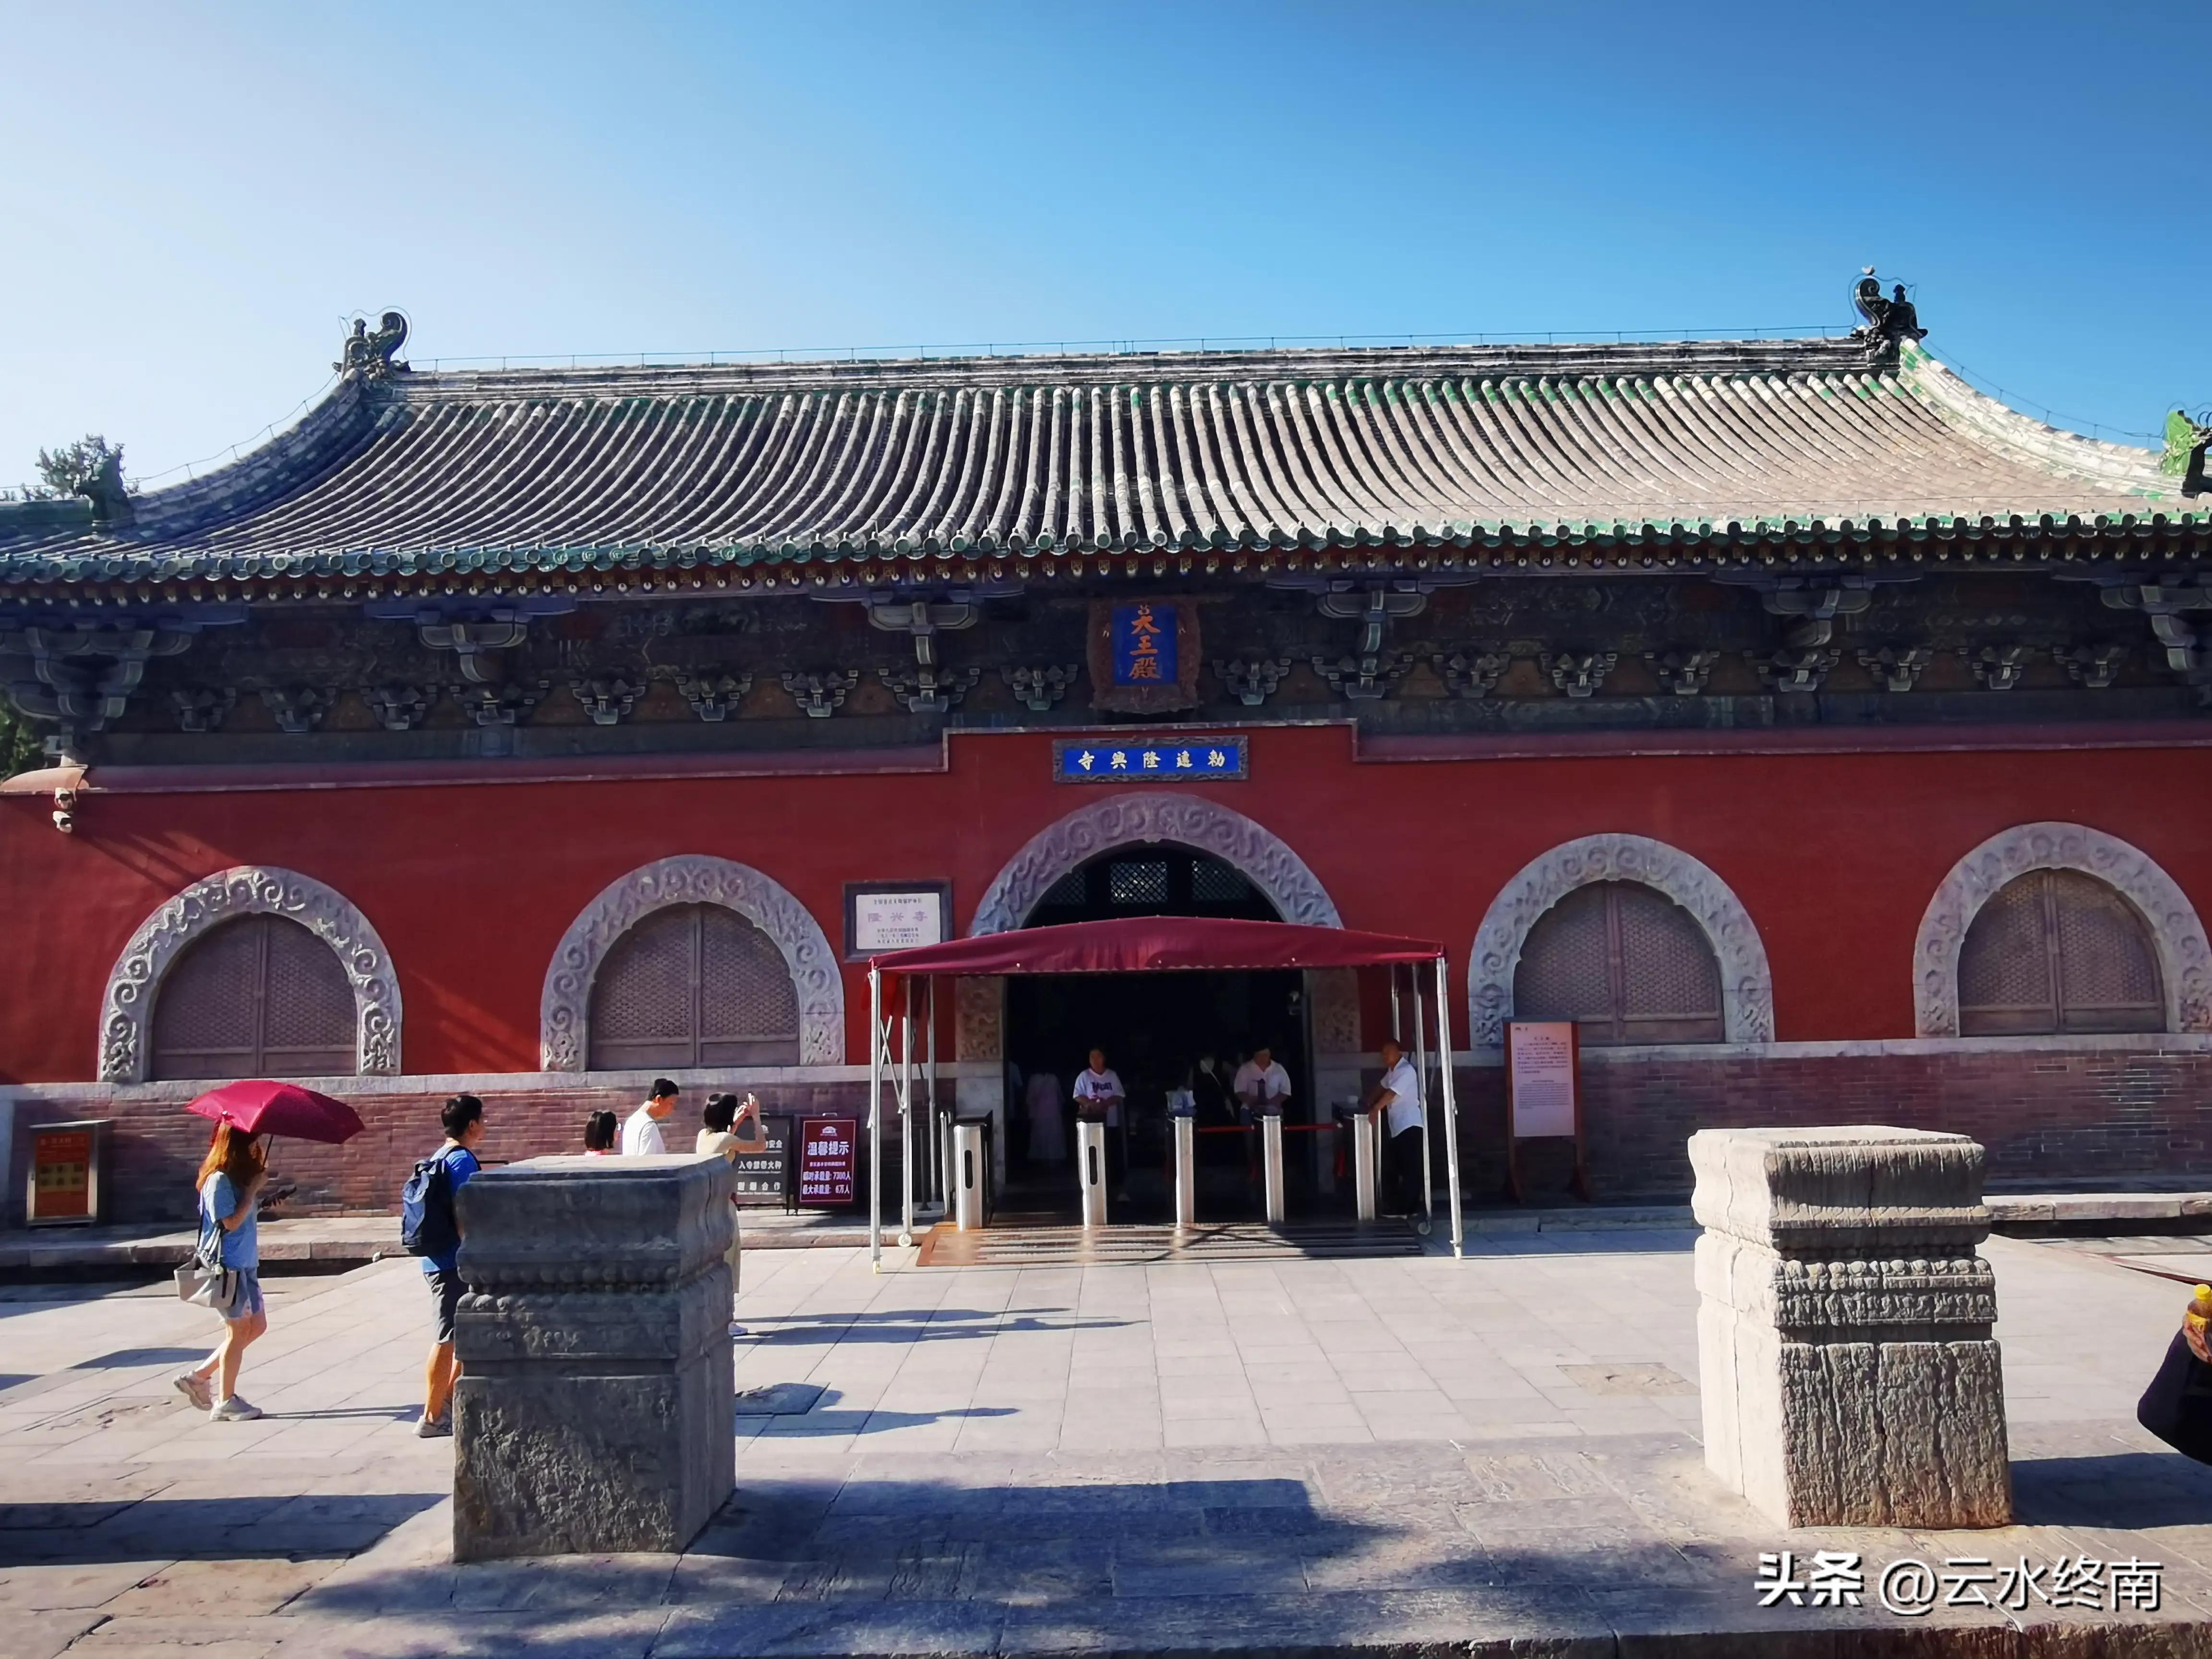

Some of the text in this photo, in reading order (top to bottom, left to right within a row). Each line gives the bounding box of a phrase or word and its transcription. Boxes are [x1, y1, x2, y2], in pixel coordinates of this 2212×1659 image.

[1130, 609, 1161, 679] 天王殿
[807, 1141, 849, 1155] 温馨提示
